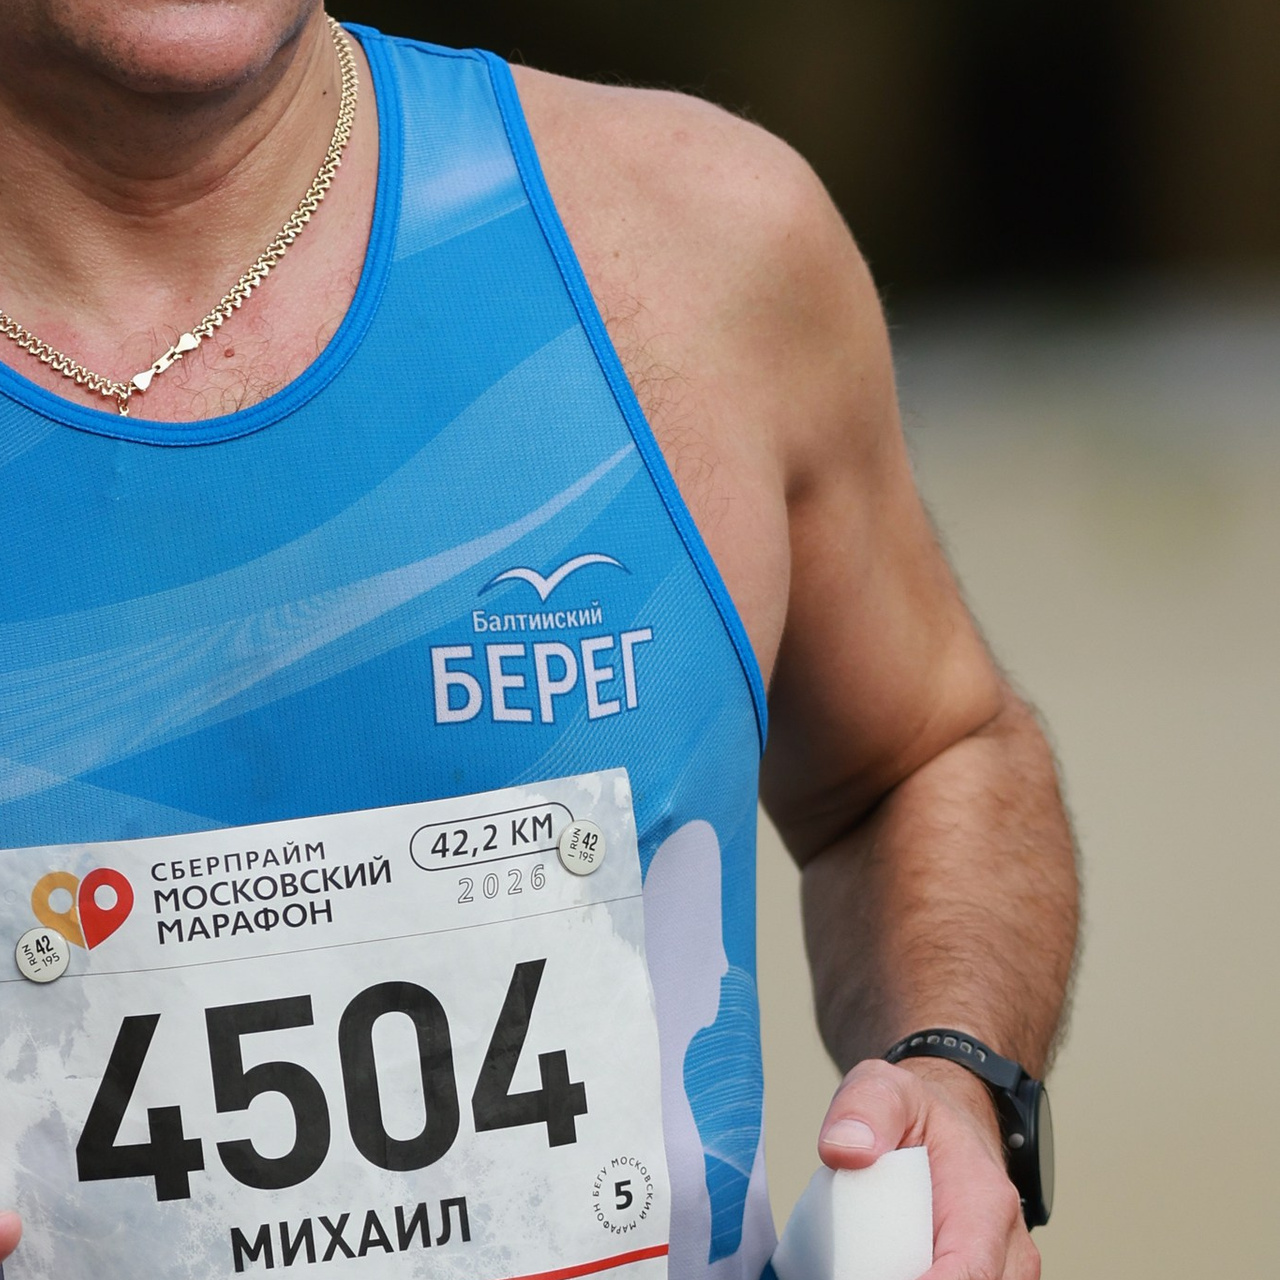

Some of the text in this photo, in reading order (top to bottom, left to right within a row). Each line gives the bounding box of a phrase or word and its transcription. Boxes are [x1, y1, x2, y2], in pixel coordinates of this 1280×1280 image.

[430, 626, 654, 726] БЕРЕГ
[431, 812, 553, 858] 42,2 КМ
[569, 827, 582, 850] RUN
[581, 831, 599, 852] 42
[150, 840, 326, 882] СБЕРПРАЙМ
[578, 850, 595, 864] 195
[153, 854, 392, 914] МОСКОВСКИЙ
[457, 863, 546, 904] 2026
[156, 898, 333, 945] МАРАФОН
[21, 943, 38, 966] RUN
[35, 934, 54, 955] 42
[41, 951, 61, 967] 195
[75, 957, 589, 1203] 4504
[592, 1156, 654, 1235] БЕГУ МОСКОВСКИЙ МАРАФОН
[614, 1179, 634, 1211] 5
[229, 1195, 473, 1274] МИХАИЛ
